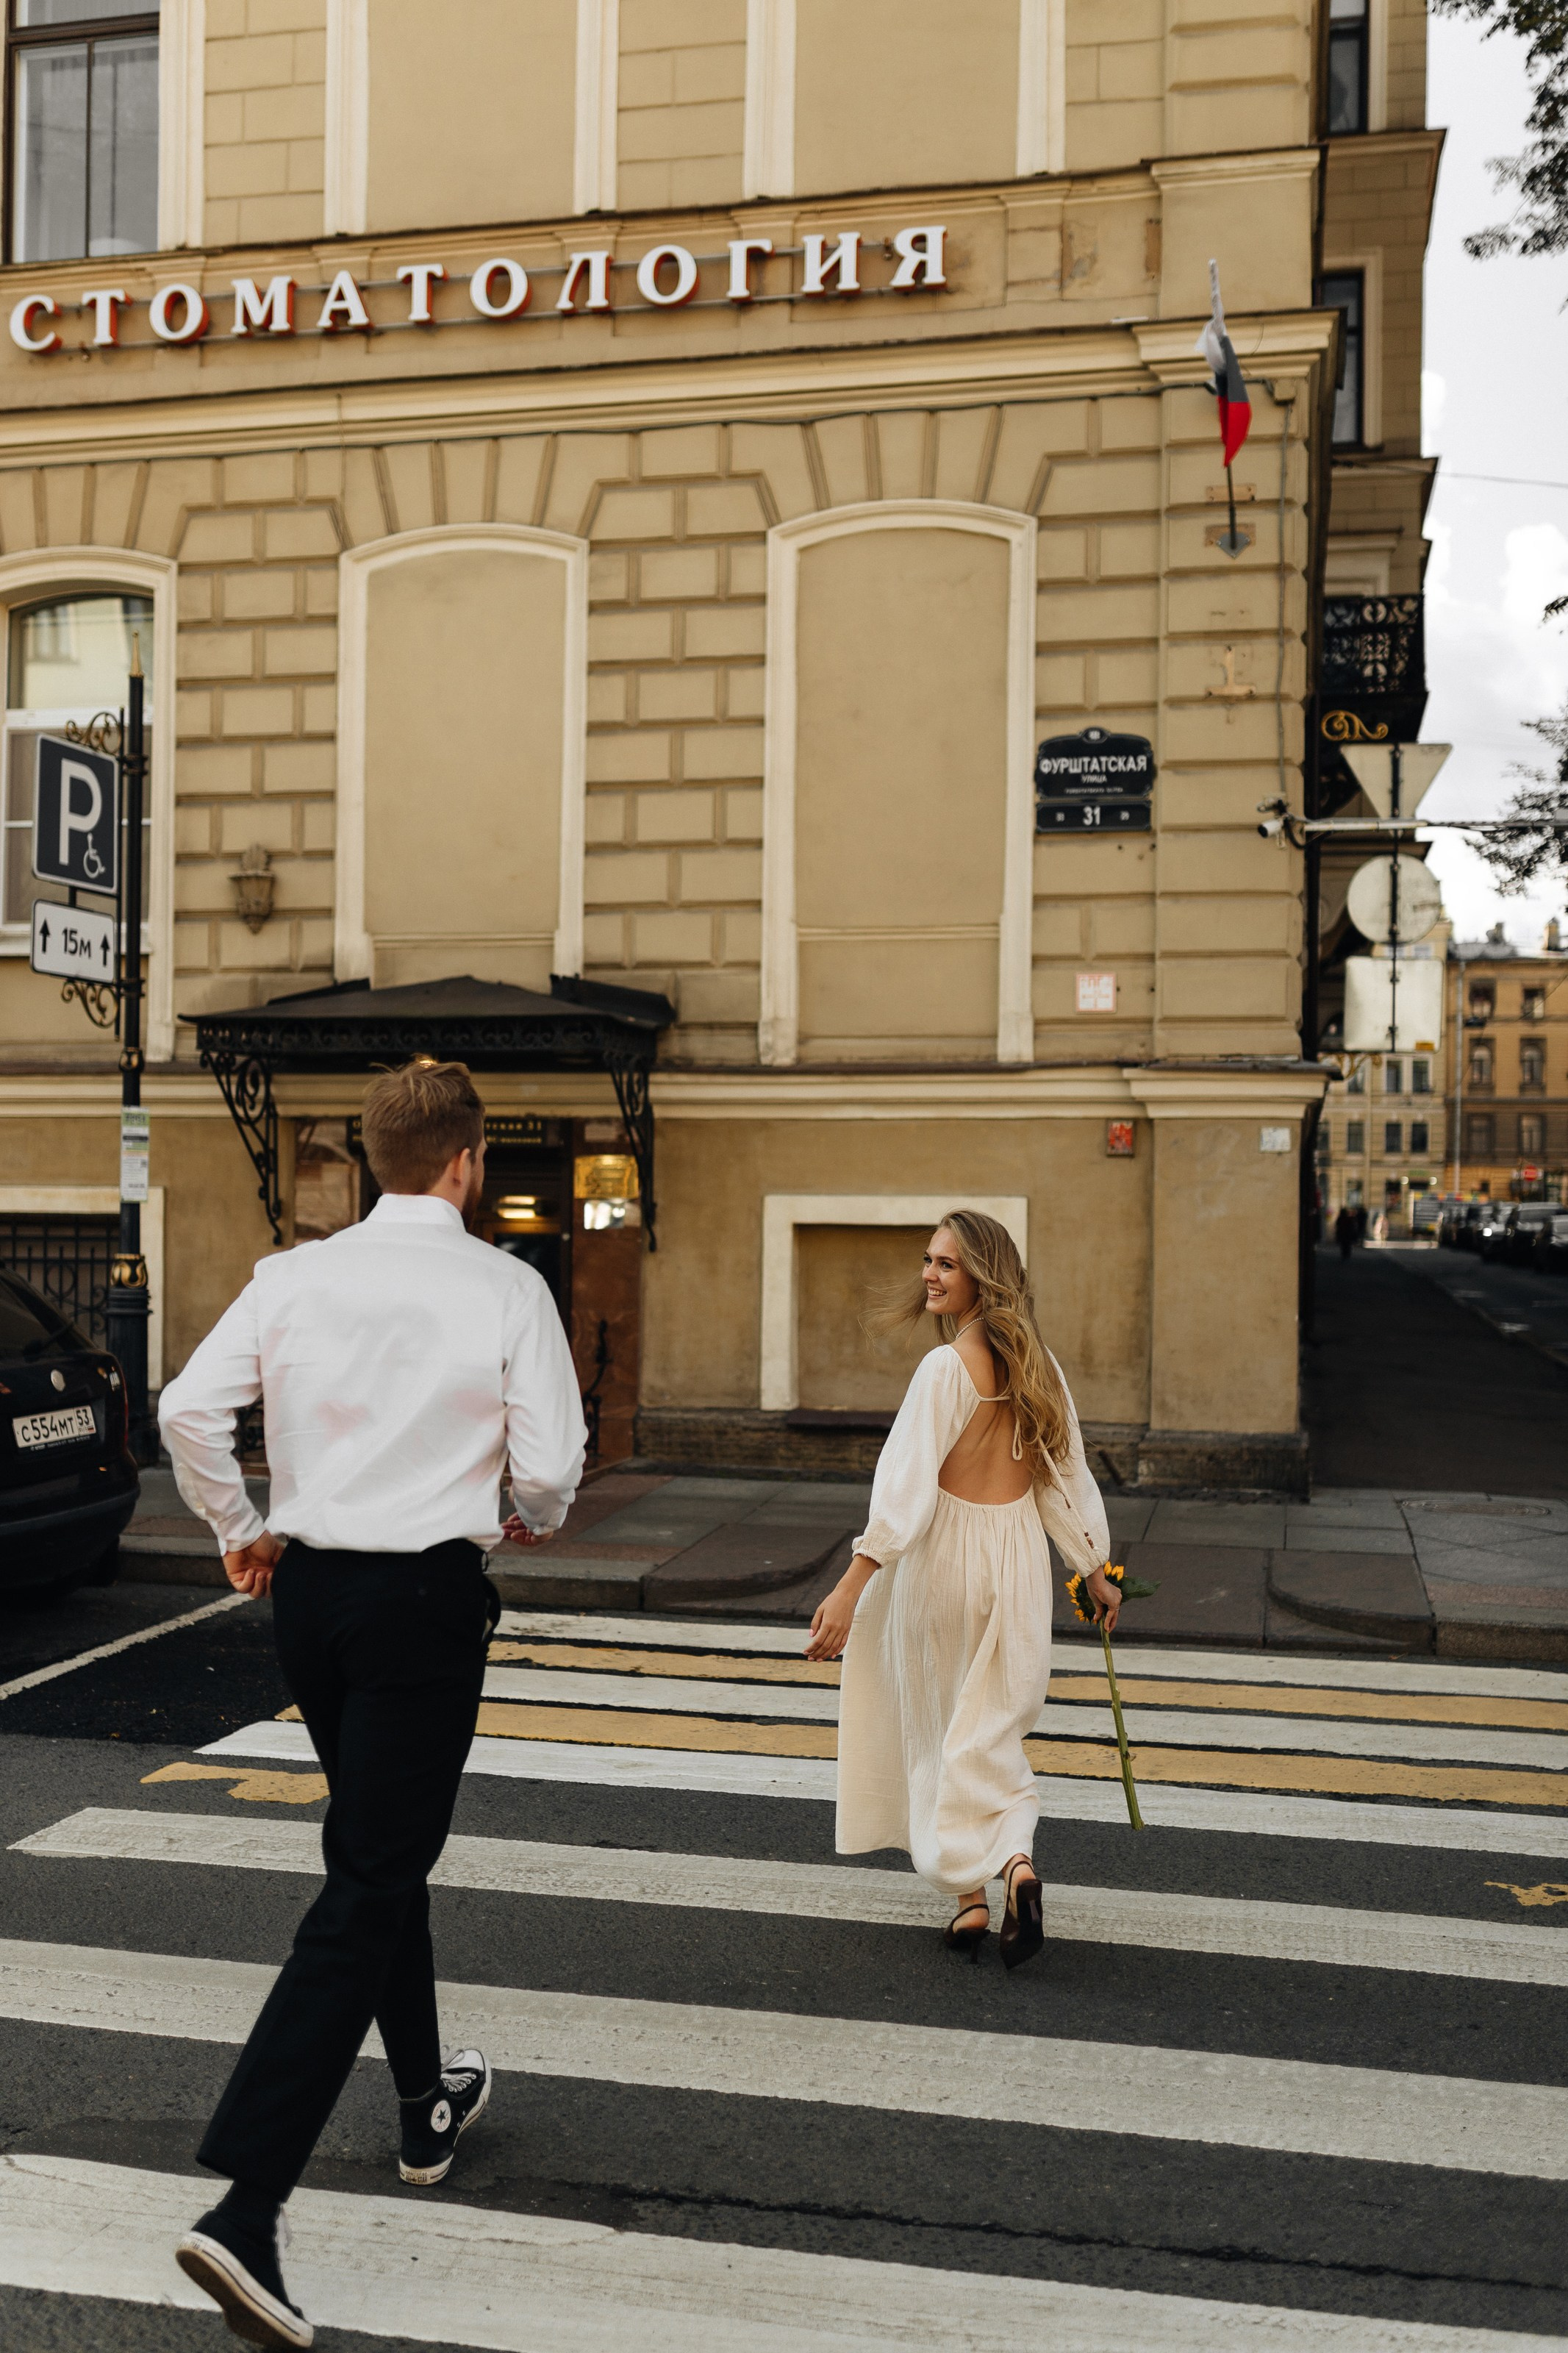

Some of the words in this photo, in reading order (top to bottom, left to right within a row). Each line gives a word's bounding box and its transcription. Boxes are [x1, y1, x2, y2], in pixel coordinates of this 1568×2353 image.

[9, 225, 948, 354] СТОМАТОЛОГИЯ
[1039, 754, 1148, 774] ФУРШТАТСКАЯ
[1081, 774, 1107, 784] УЛИЦА
[59, 757, 102, 866] P
[1083, 806, 1101, 826] 31
[76, 1409, 90, 1426] 53
